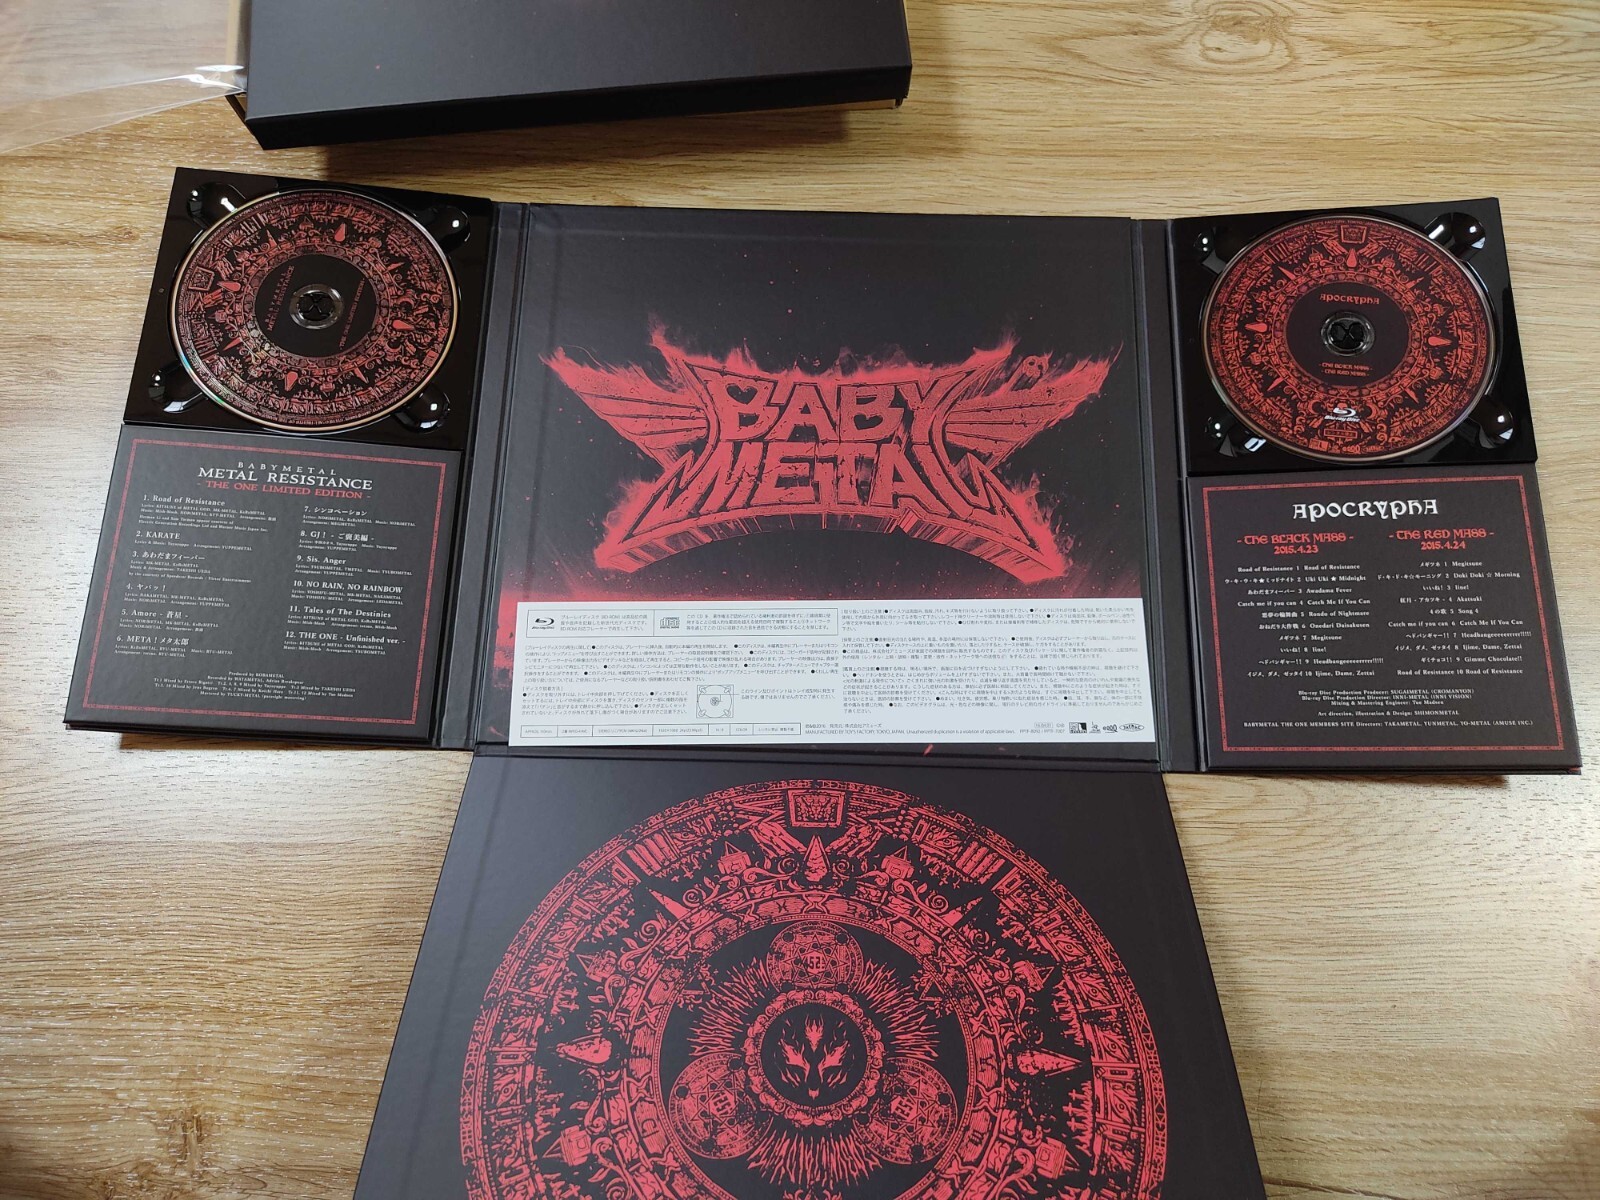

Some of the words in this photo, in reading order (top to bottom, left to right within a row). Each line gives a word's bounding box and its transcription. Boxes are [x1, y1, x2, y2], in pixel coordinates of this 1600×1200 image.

[1320, 294, 1379, 304] APOCRYPHA
[238, 462, 336, 475] BABYMETAL
[198, 468, 258, 481] METAL
[268, 473, 372, 490] RESISTANCE
[206, 480, 229, 489] THE
[234, 482, 257, 491] ONE
[262, 485, 310, 495] LIMITED
[315, 488, 363, 499] EDITION
[185, 497, 225, 506] Resistance
[314, 507, 367, 516] シンコペーション
[1293, 499, 1438, 522] APOCRYPHA
[146, 531, 180, 539] KARATE
[1244, 535, 1268, 544] THE
[1271, 533, 1310, 544] BLACK
[1313, 532, 1346, 544] MASS
[1396, 530, 1420, 540] THE
[1424, 530, 1450, 539] RED
[1453, 528, 1486, 539] MASS
[1274, 545, 1318, 554] 2015.4.23
[1421, 541, 1466, 550] 2015.4.24
[142, 551, 205, 560] あわだまフィーバー
[307, 555, 320, 563] Sis.
[323, 556, 346, 565] Anger
[322, 581, 345, 590] RAIN,
[363, 585, 403, 593] RAINBOW
[304, 606, 323, 614] Tales
[356, 609, 391, 618] Destinies
[346, 635, 384, 643] Unfinished
